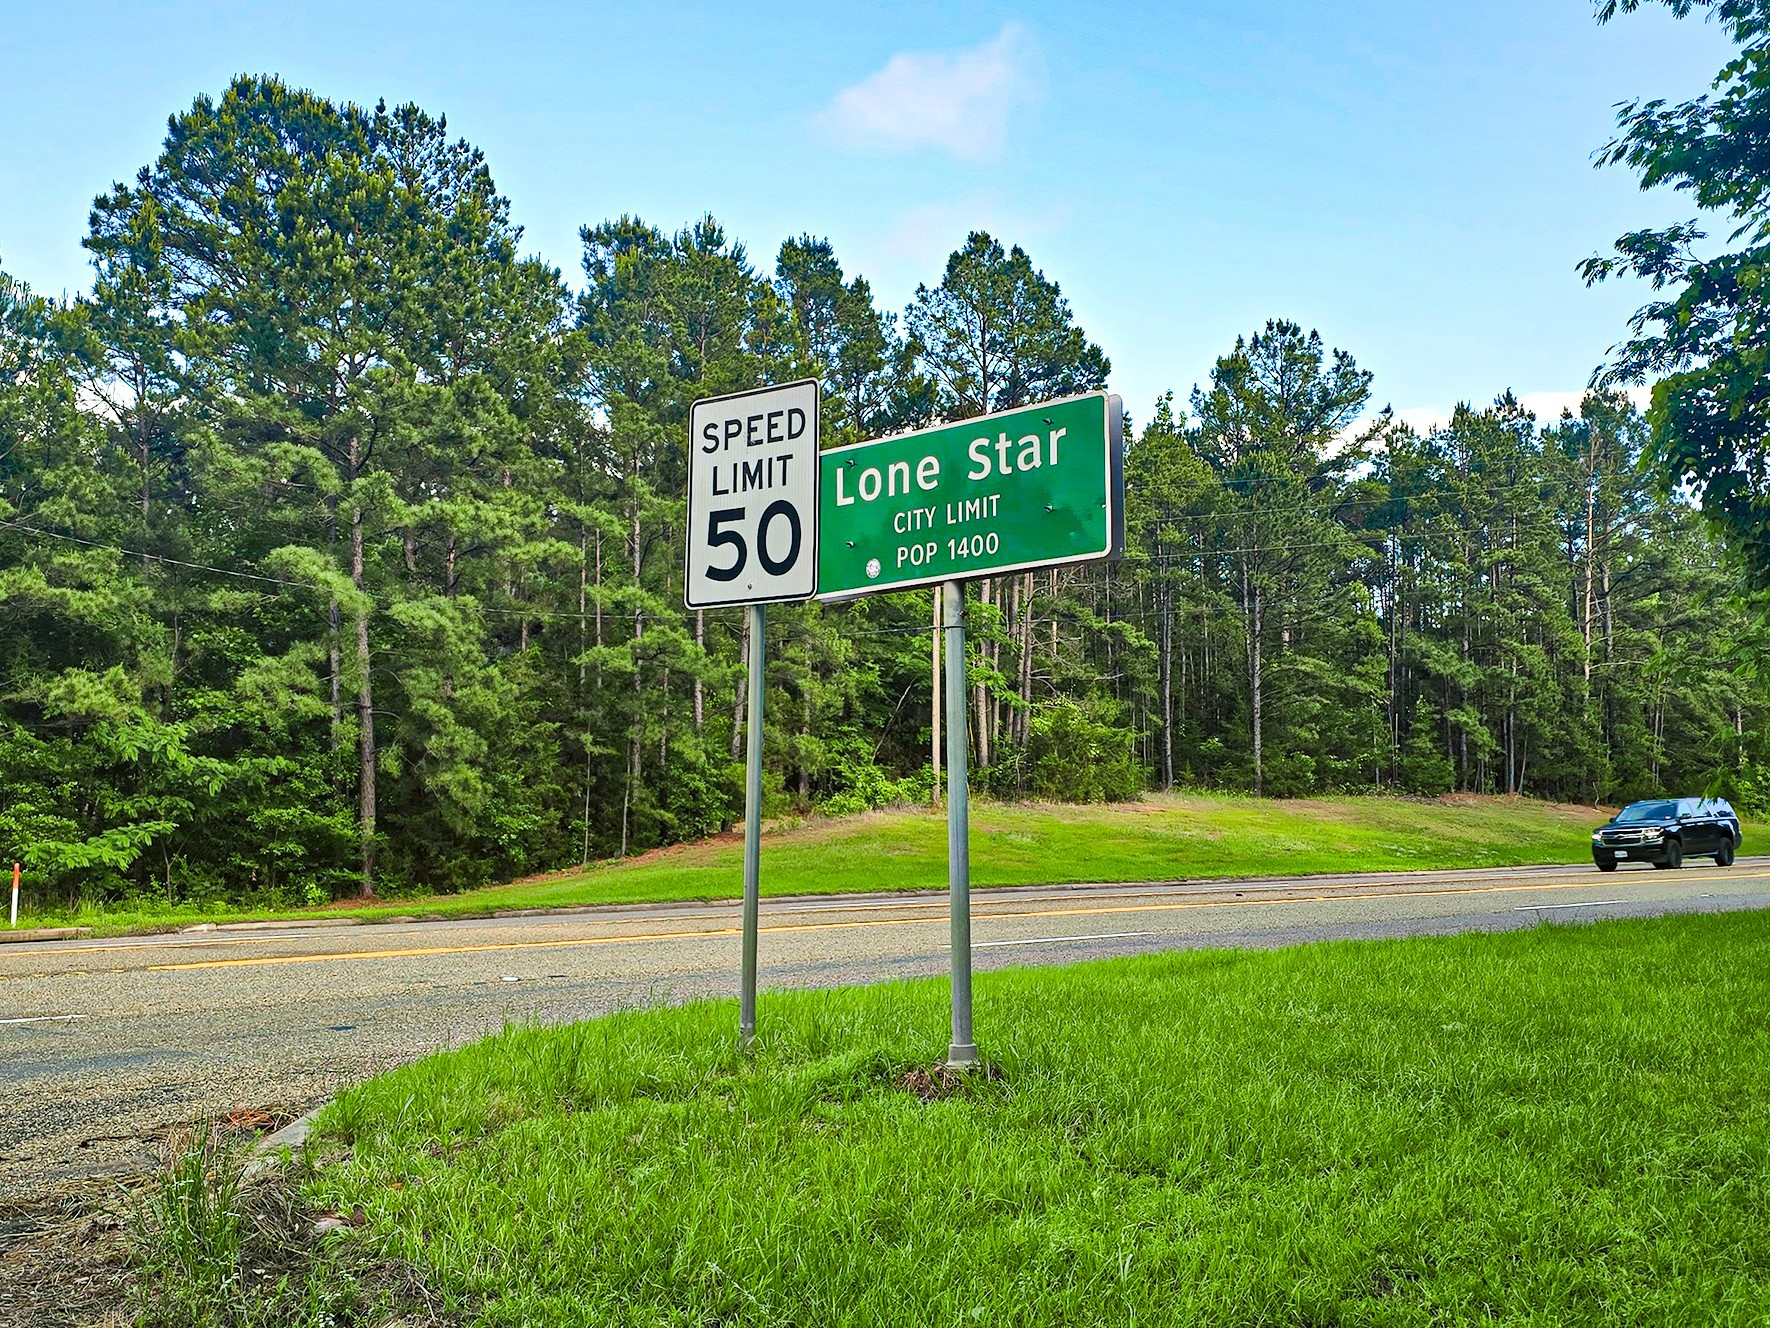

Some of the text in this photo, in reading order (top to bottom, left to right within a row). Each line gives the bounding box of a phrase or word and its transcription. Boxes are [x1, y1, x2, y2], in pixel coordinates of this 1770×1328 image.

[701, 407, 806, 454] SPEED
[712, 454, 793, 496] LIMIT
[835, 426, 1067, 507] Lone Star
[893, 494, 1000, 534] CITY LIMIT
[705, 499, 801, 582] 50
[897, 532, 999, 569] POP 1400
